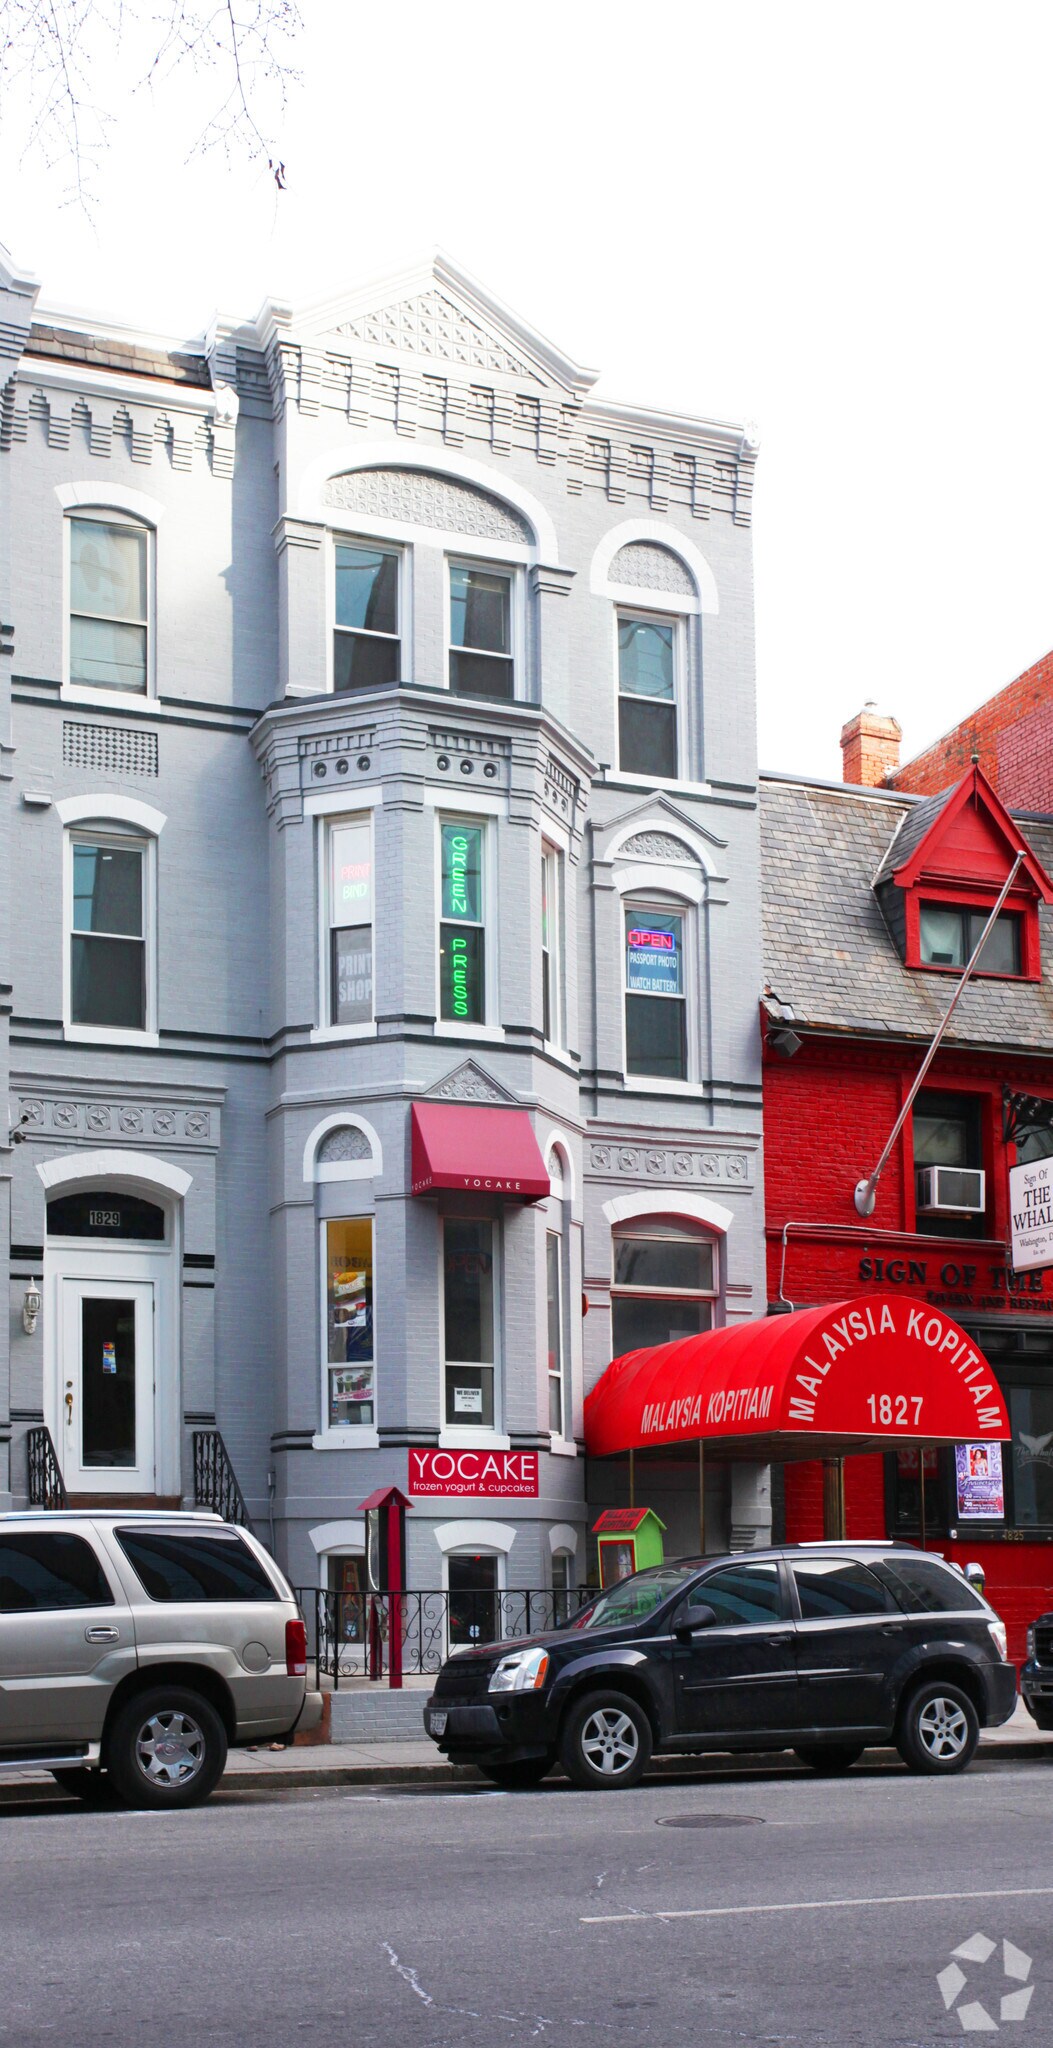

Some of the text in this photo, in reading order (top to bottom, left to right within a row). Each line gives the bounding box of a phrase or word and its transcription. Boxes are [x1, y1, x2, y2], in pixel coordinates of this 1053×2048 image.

[341, 863, 371, 880] PRINT
[452, 836, 467, 913] GREEN
[343, 882, 368, 899] BIND
[628, 931, 672, 949] OPEN
[338, 953, 372, 976] PRINT
[630, 952, 677, 968] PASSPORT PHOTO
[453, 938, 468, 1016] PRESS
[630, 976, 677, 992] WATCH BATTERY
[338, 979, 372, 1002] SHOP
[411, 1177, 432, 1191] YOCAKE
[464, 1178, 520, 1190] YOCAKE
[1024, 1168, 1048, 1187] Sign Of
[1023, 1185, 1051, 1208] THE
[91, 1211, 119, 1225] 1829
[859, 1257, 927, 1284] SIGN
[941, 1263, 977, 1287] OF
[788, 1304, 1003, 1429] MALAYSIA KOPITIAM
[641, 1385, 774, 1434] MALAYSIA KOPITIAM
[867, 1394, 924, 1425] 1827
[413, 1453, 534, 1480] YOCAKE
[413, 1481, 535, 1493] frozen yogurt & cupcakes
